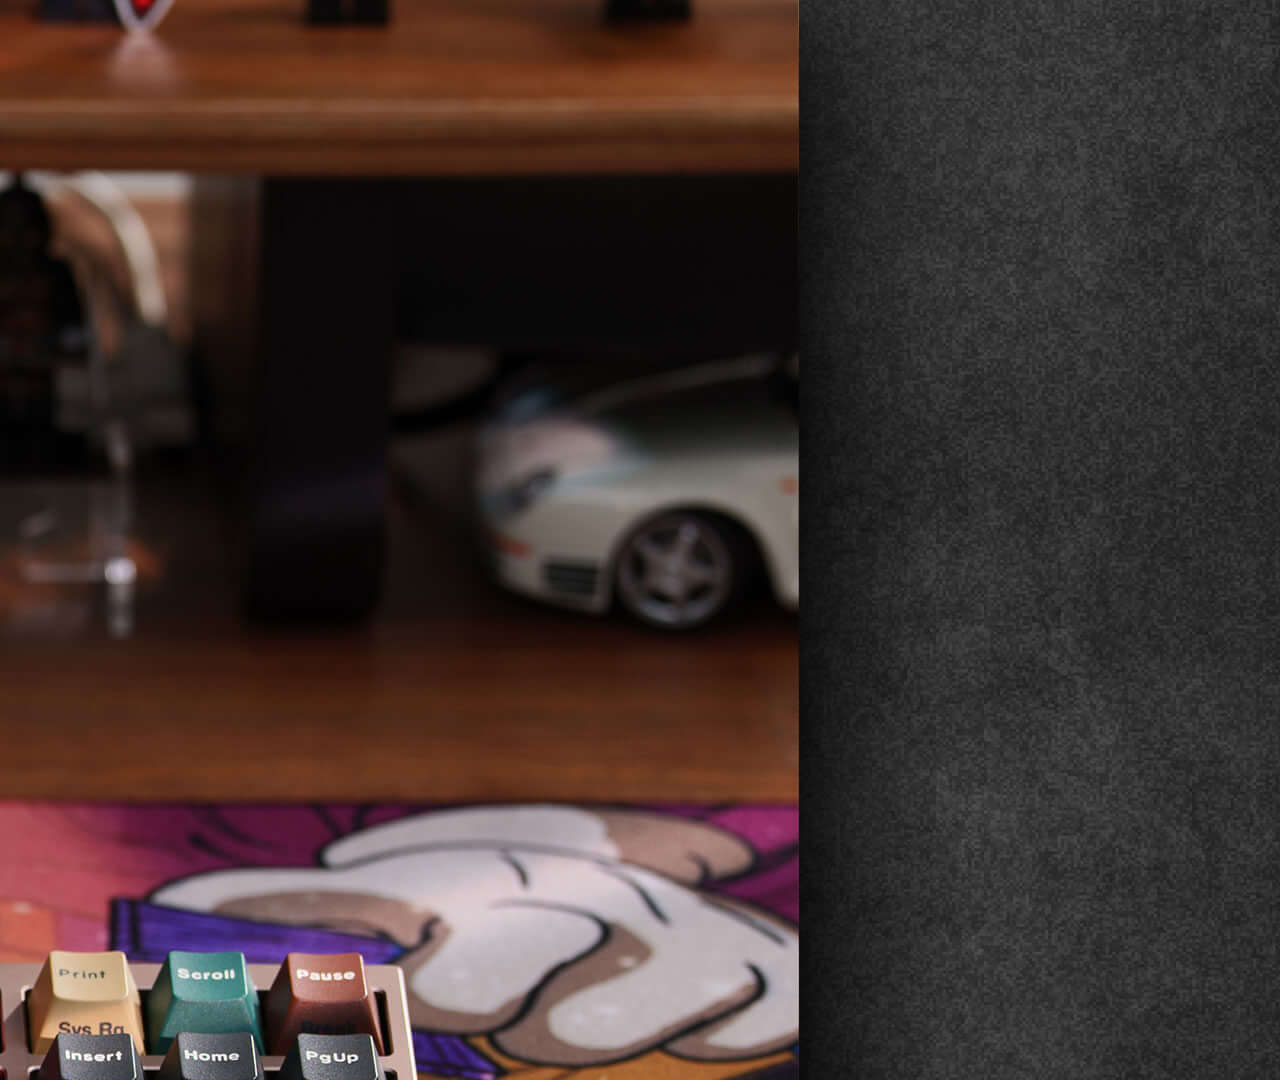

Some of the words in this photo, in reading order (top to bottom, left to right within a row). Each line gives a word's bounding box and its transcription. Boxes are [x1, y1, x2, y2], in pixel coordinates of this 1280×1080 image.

[58, 968, 106, 979] Print
[176, 967, 236, 981] Scroll
[295, 968, 356, 982] Pause
[63, 1048, 123, 1062] Insert
[183, 1047, 240, 1062] Home
[305, 1049, 359, 1065] PgUp
